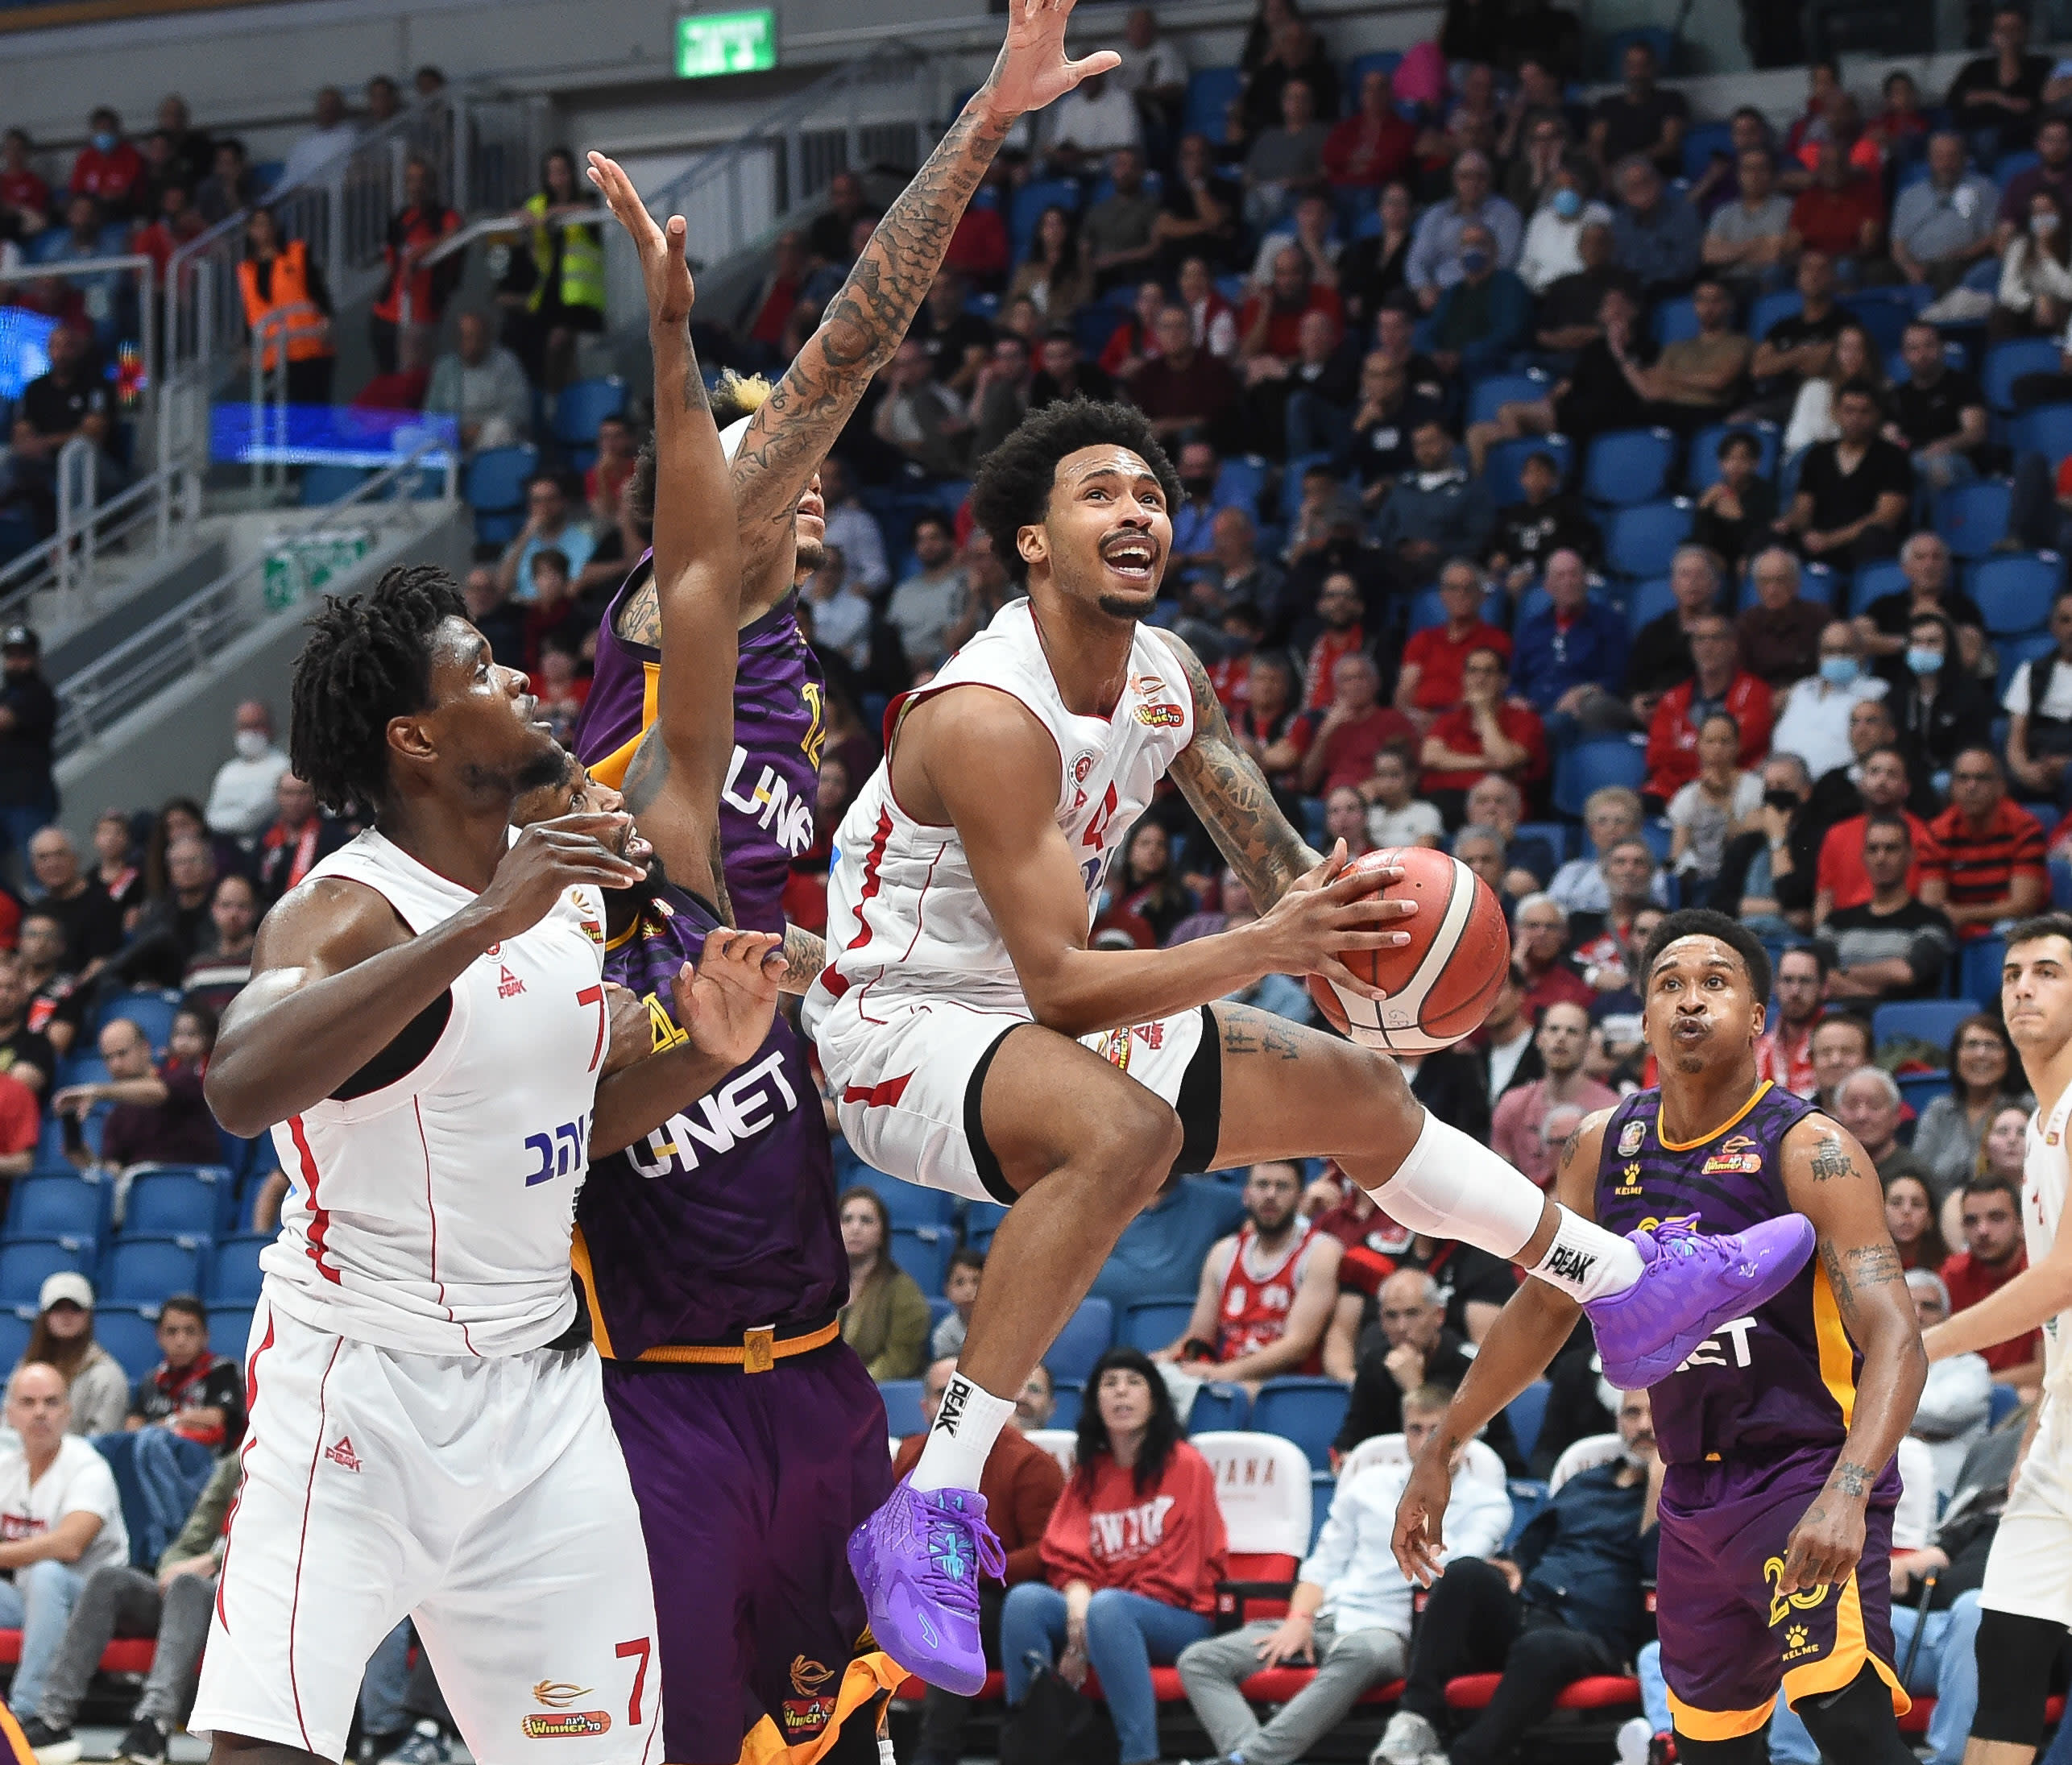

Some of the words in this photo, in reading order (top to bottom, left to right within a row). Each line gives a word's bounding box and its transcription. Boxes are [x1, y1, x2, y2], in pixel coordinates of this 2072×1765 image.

[801, 682, 827, 773] 1
[1082, 779, 1117, 852] 4
[497, 980, 528, 999] PEAK
[576, 984, 604, 1073] 7
[1544, 1244, 1598, 1285] PEAK
[934, 1379, 974, 1439] PEAK
[325, 1446, 363, 1473] PEAK
[1781, 1643, 1821, 1662] KELME
[615, 1636, 651, 1726] 7
[532, 1719, 586, 1734] Winner
[586, 1720, 601, 1731] סל
